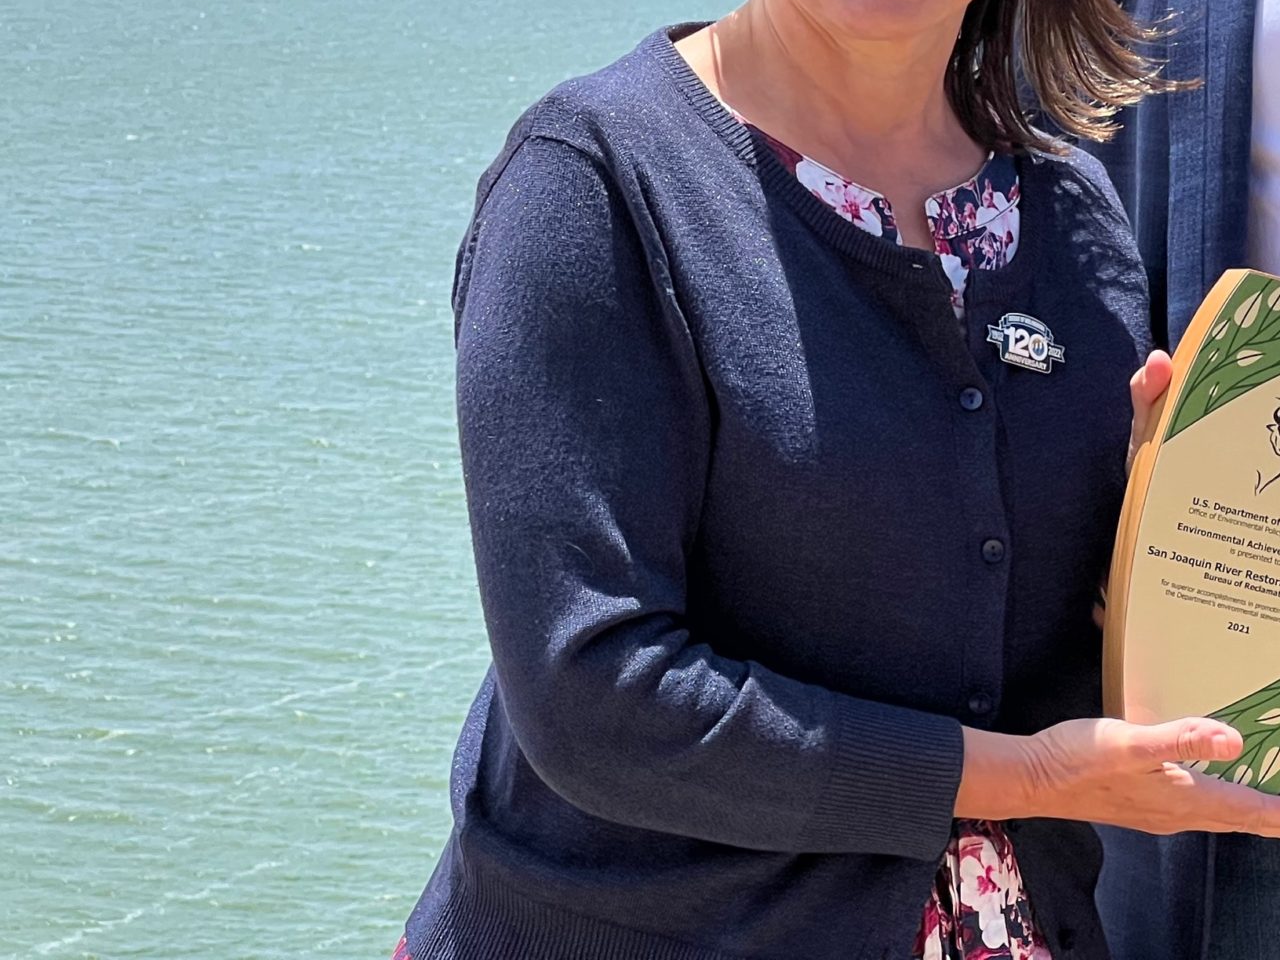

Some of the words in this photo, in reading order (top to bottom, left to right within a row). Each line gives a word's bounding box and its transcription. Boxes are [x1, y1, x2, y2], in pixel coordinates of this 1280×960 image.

[1004, 326, 1048, 361] 120
[1004, 352, 1047, 370] ANNIVERSARY
[1188, 507, 1208, 518] Office
[1217, 514, 1264, 531] Environmental
[1192, 497, 1210, 509] U.S.
[1213, 502, 1269, 523] Department
[1271, 517, 1280, 526] of
[1176, 522, 1245, 546] Environmental
[1147, 545, 1168, 558] San
[1169, 551, 1212, 569] Joaquin
[1214, 562, 1243, 576] River
[1229, 547, 1235, 555] is
[1237, 550, 1272, 563] presented
[1161, 578, 1170, 586] for
[1171, 582, 1195, 592] superior
[1203, 572, 1232, 585] Bureau
[1176, 591, 1215, 607] Department's
[1217, 603, 1259, 617] environmental
[1227, 621, 1250, 634] 2021
